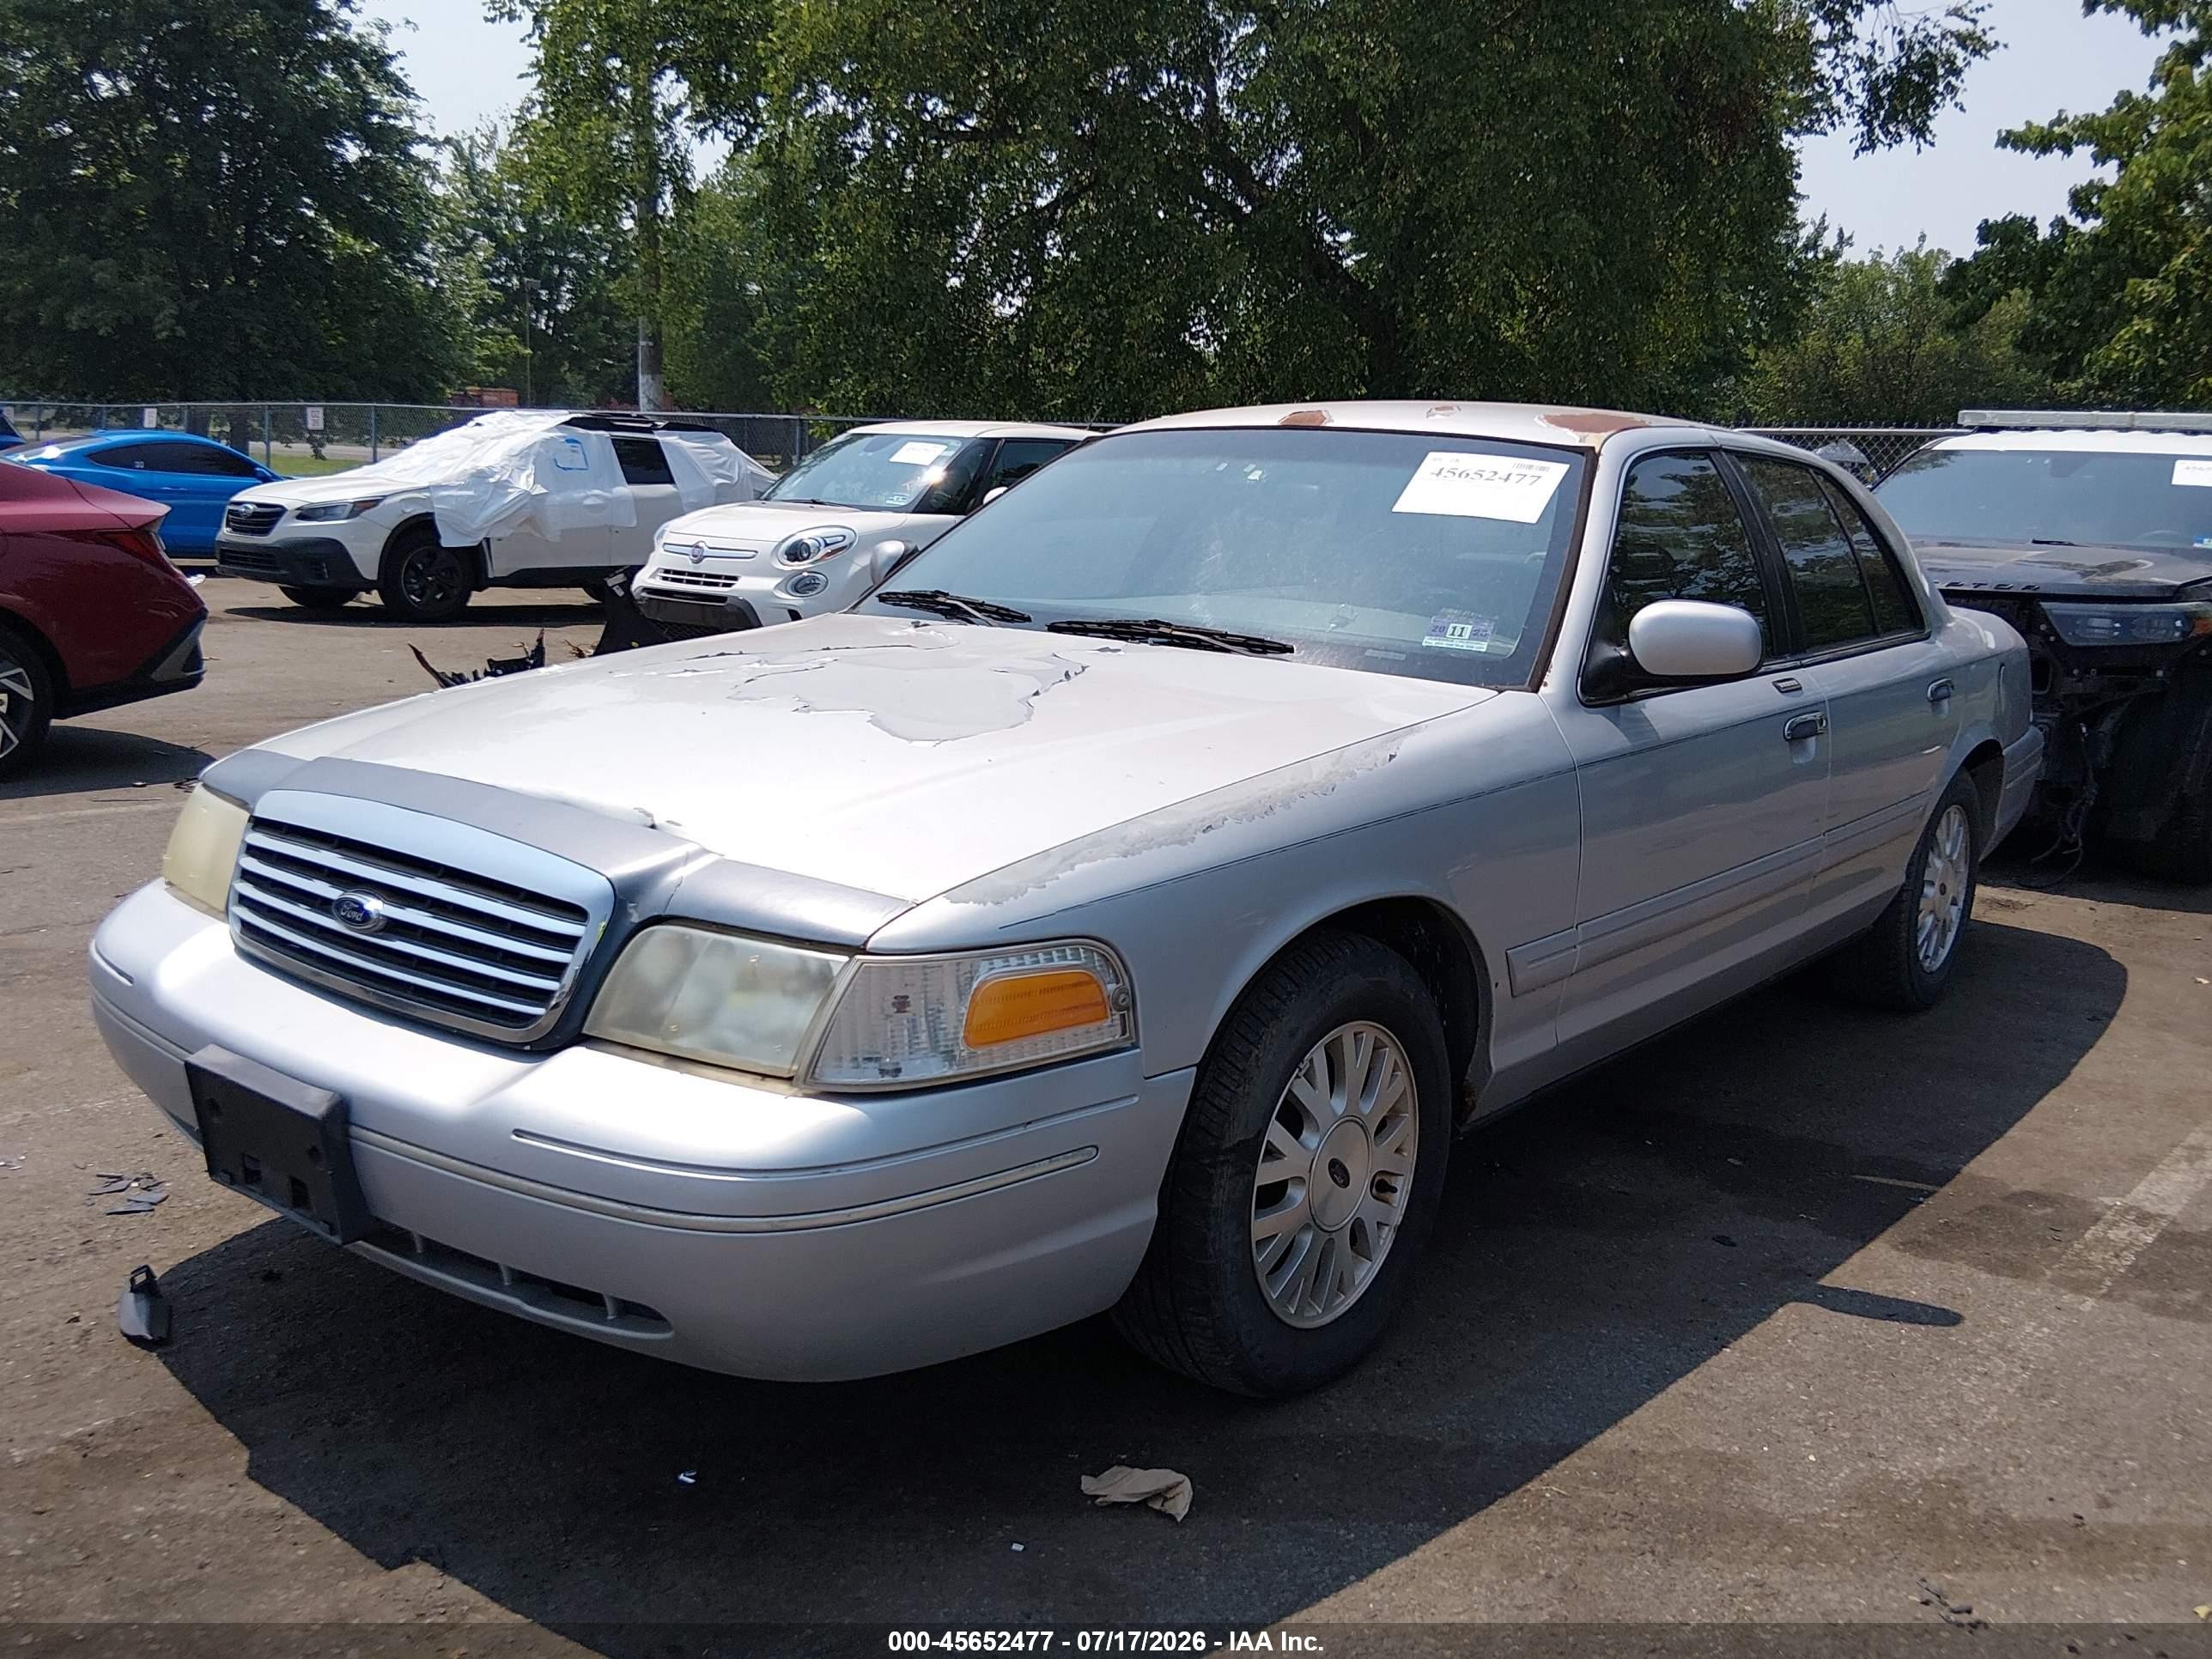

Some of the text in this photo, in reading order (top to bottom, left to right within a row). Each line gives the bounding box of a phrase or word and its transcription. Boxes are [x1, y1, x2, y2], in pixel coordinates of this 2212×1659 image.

[1431, 465, 1543, 486] 45652477
[1431, 624, 1446, 633] 20
[1448, 625, 1466, 637] 11
[340, 901, 365, 921] Ford
